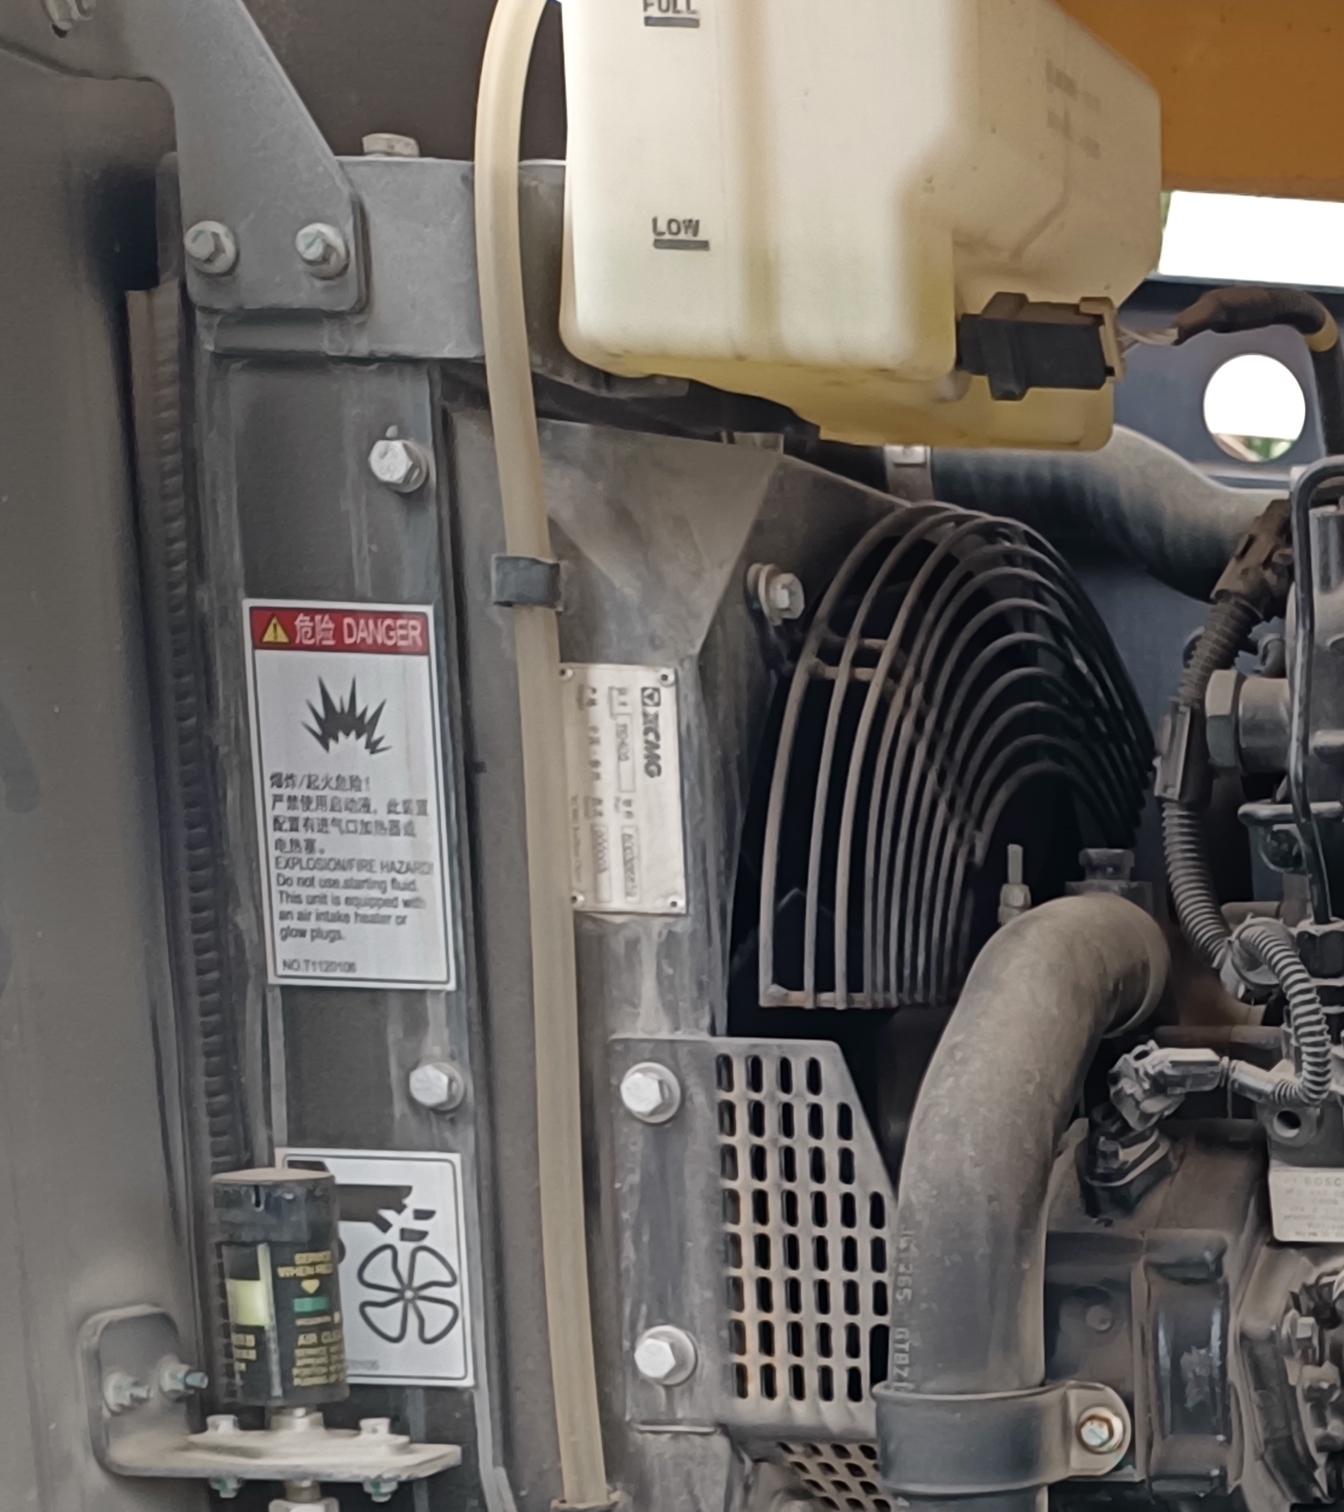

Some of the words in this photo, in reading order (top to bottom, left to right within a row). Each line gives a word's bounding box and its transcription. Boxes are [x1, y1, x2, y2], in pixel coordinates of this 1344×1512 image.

[651, 216, 700, 237] LOW
[294, 613, 335, 646] 危险
[343, 618, 423, 647] DANGER
[276, 873, 294, 888] Do
[296, 875, 316, 889] not
[279, 890, 303, 905] This
[305, 893, 328, 905] unit
